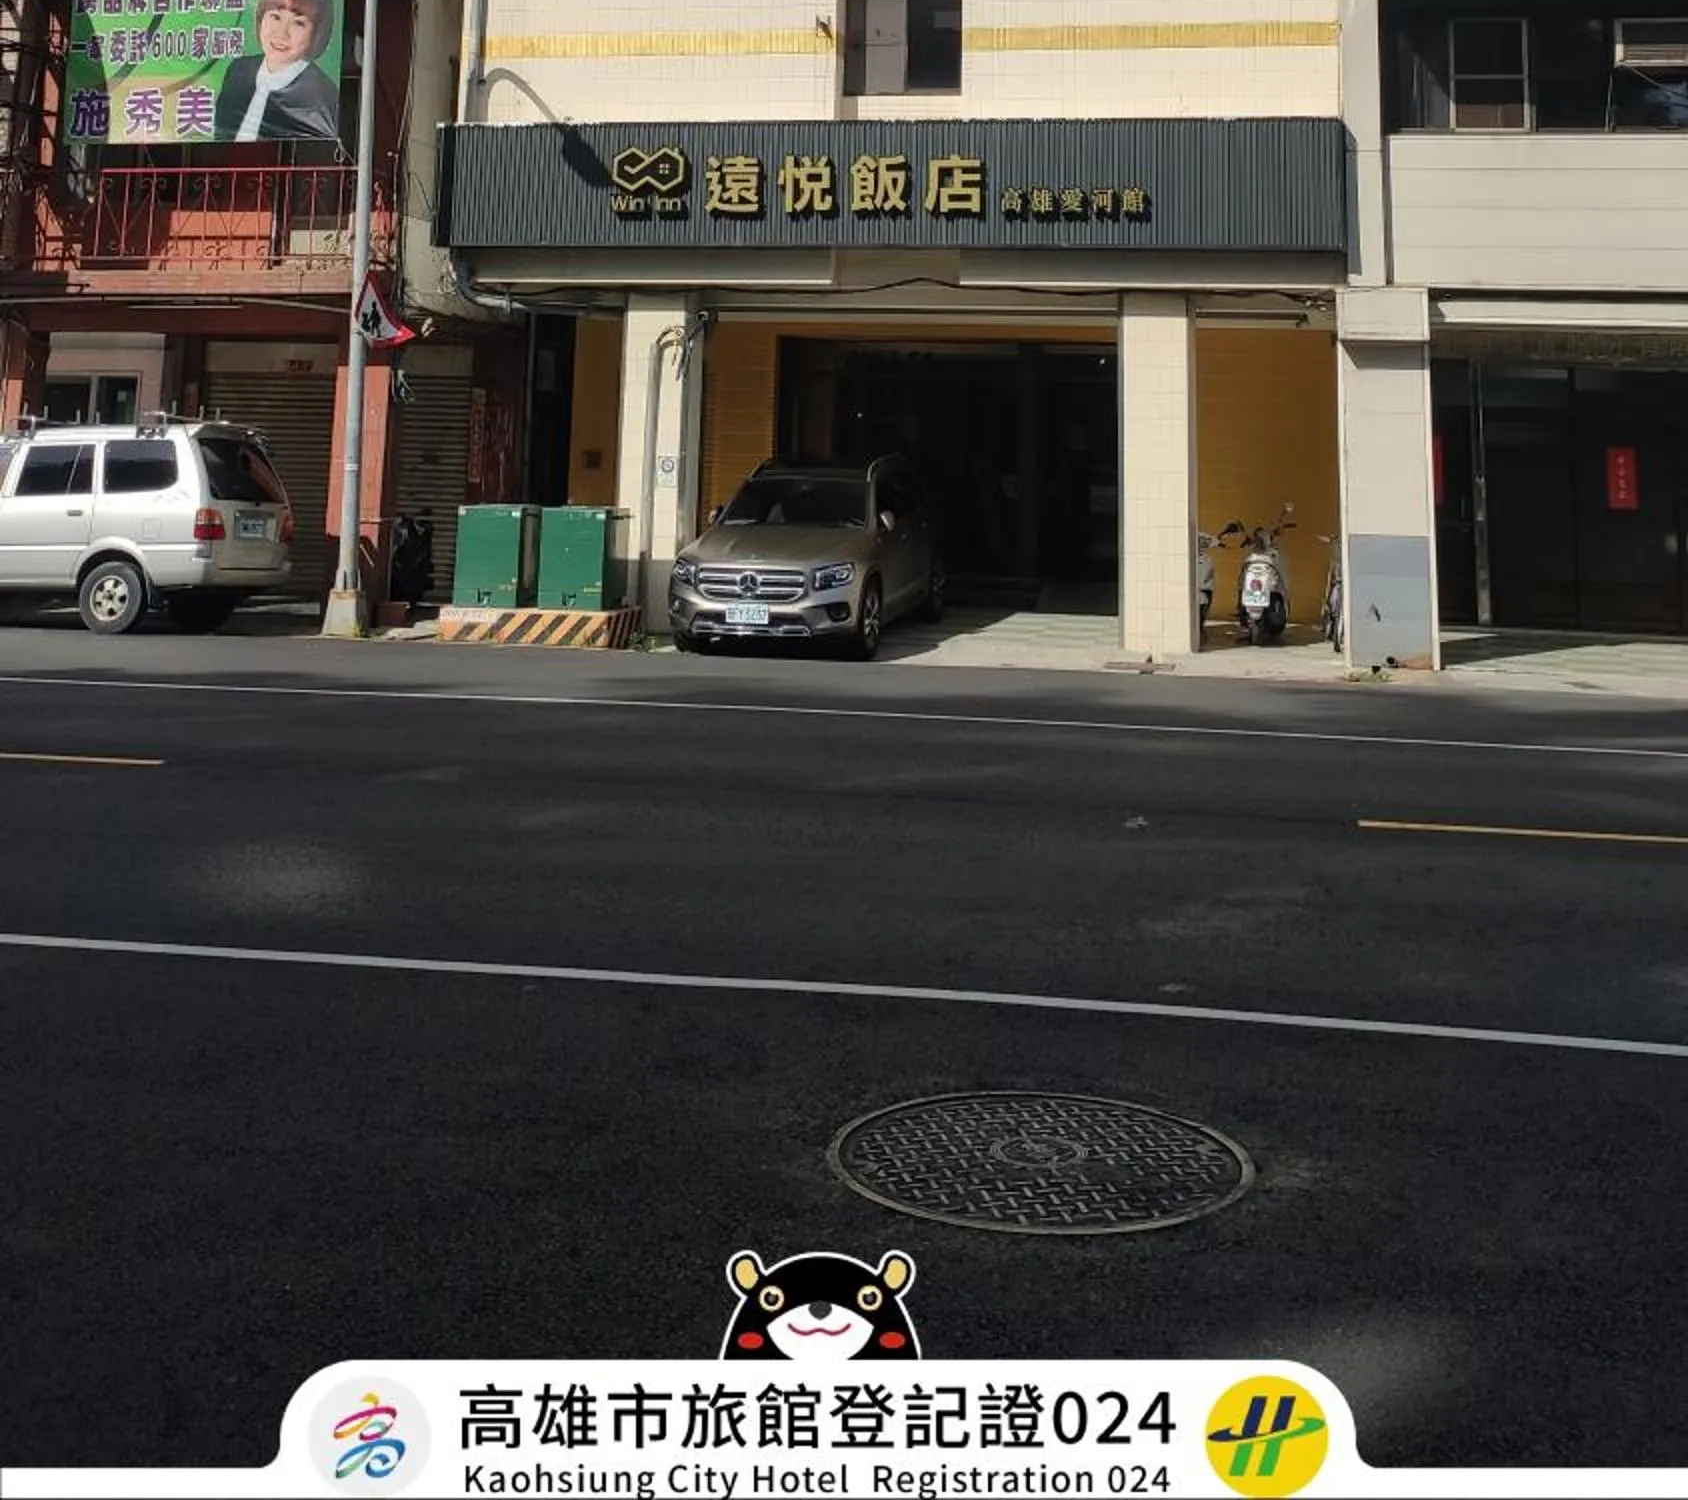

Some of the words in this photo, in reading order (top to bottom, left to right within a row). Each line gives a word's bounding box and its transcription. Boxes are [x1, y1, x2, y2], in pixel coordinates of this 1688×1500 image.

[70, 85, 215, 139] 施秀美
[611, 195, 645, 211] Win
[705, 155, 985, 214] 遠悅飯店
[1001, 187, 1145, 213] 高雄愛河館
